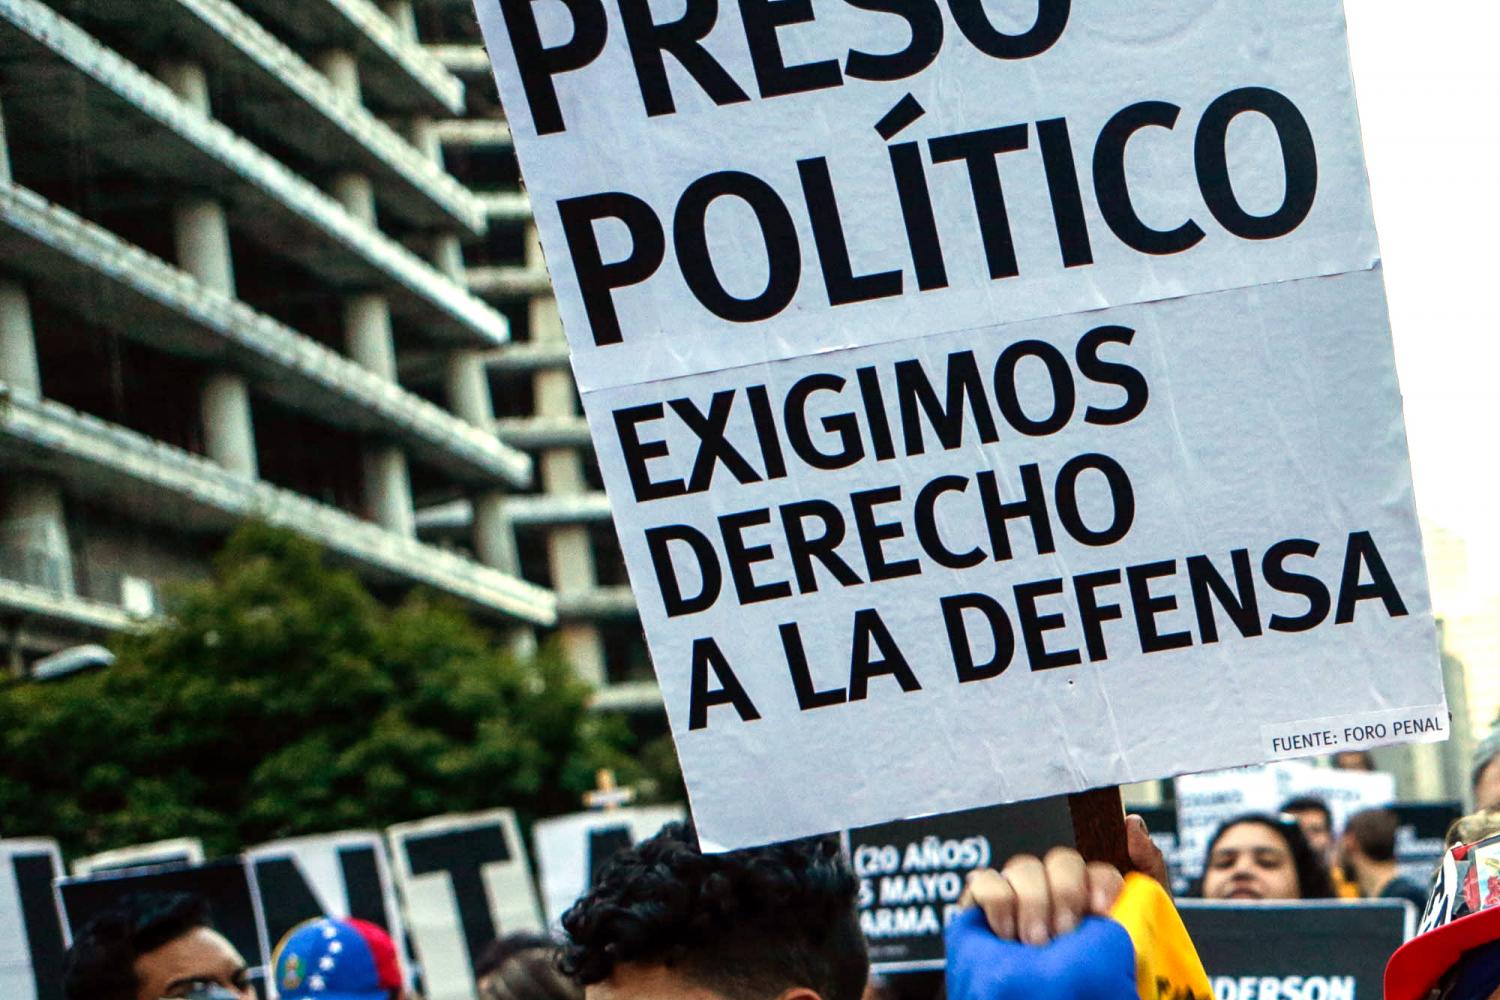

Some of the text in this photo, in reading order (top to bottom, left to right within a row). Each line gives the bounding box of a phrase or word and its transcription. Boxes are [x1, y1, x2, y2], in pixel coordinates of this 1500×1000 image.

[556, 87, 1318, 346] POLÍTICO
[612, 326, 1149, 503] EXIGIMOS
[645, 453, 1135, 618] DERECHO
[689, 531, 1409, 731] A LA DEFENSA
[1272, 717, 1443, 752] FUENTE: FORO PENAL
[854, 835, 991, 877] (20 AÑOS)
[880, 872, 961, 905] MAYO
